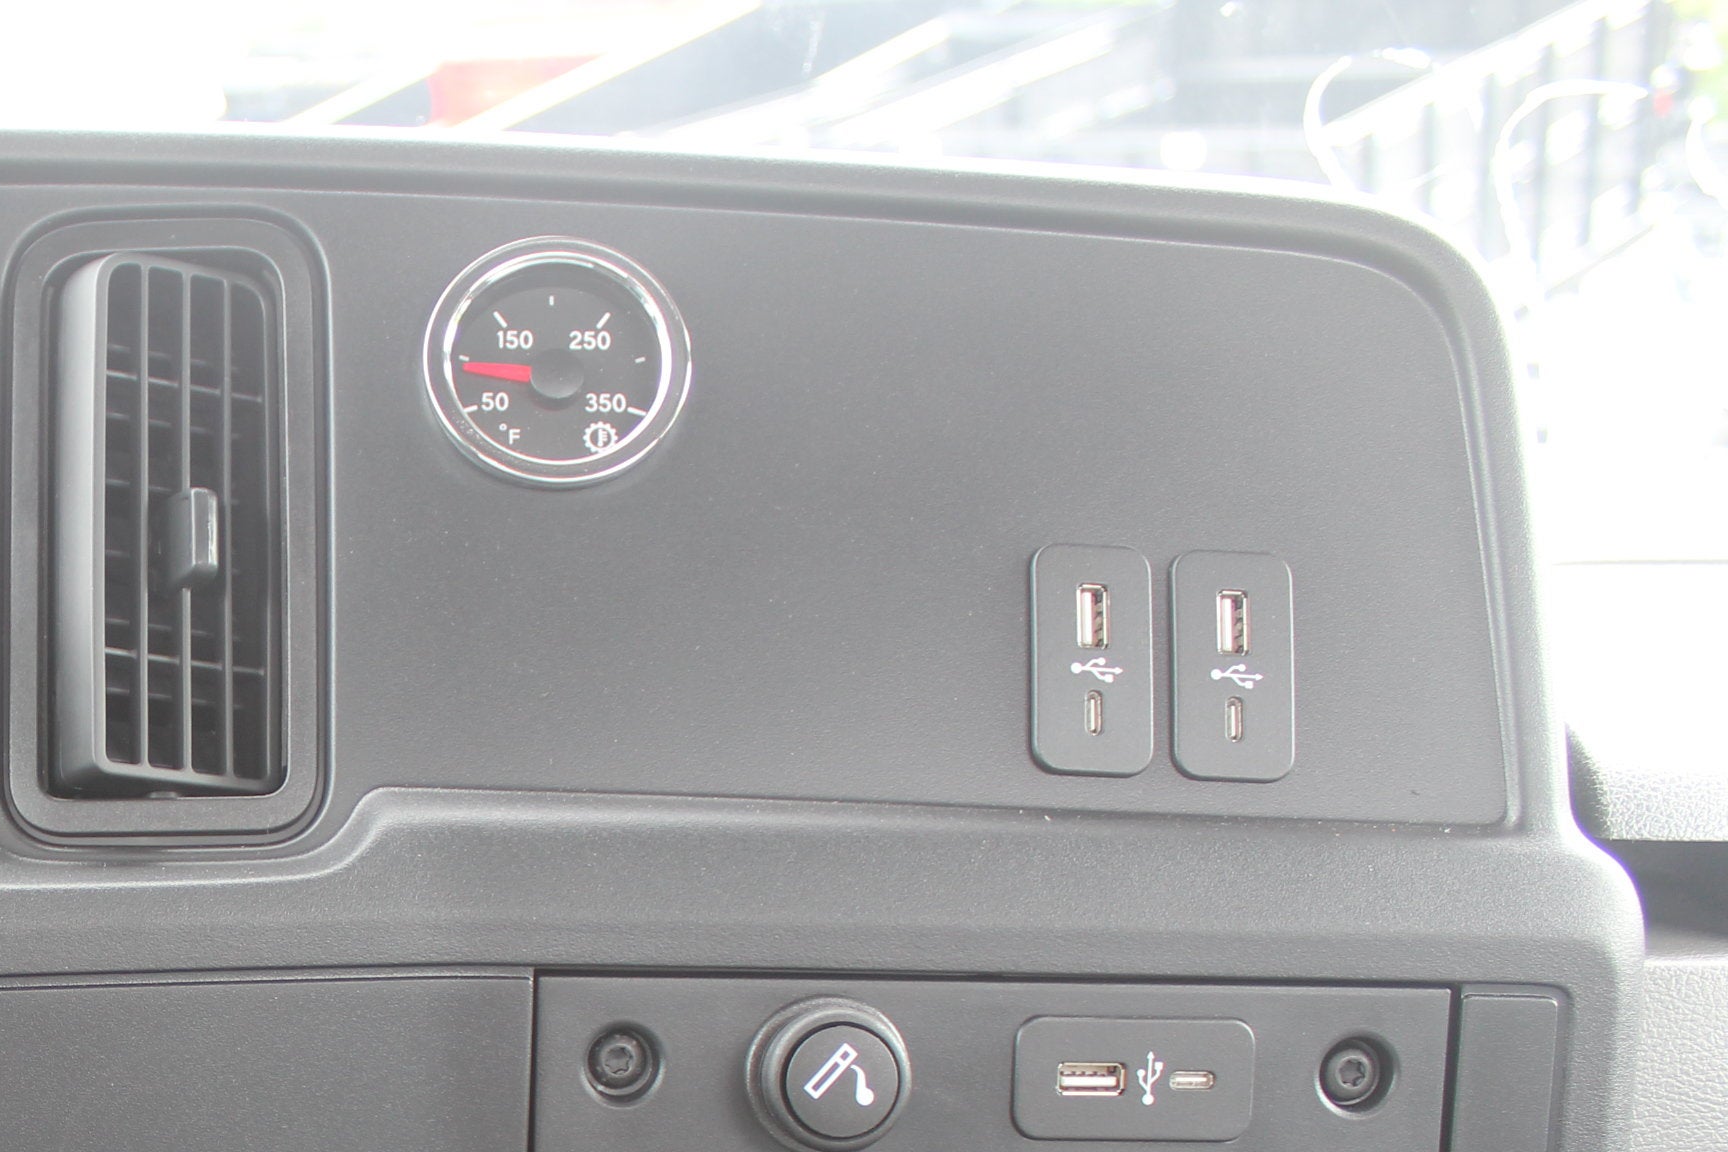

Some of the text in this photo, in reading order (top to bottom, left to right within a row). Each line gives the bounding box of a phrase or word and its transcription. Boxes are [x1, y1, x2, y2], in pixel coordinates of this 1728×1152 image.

[498, 331, 533, 349] 150
[569, 330, 611, 350] 250
[482, 392, 508, 411] 50
[585, 393, 626, 412] 350
